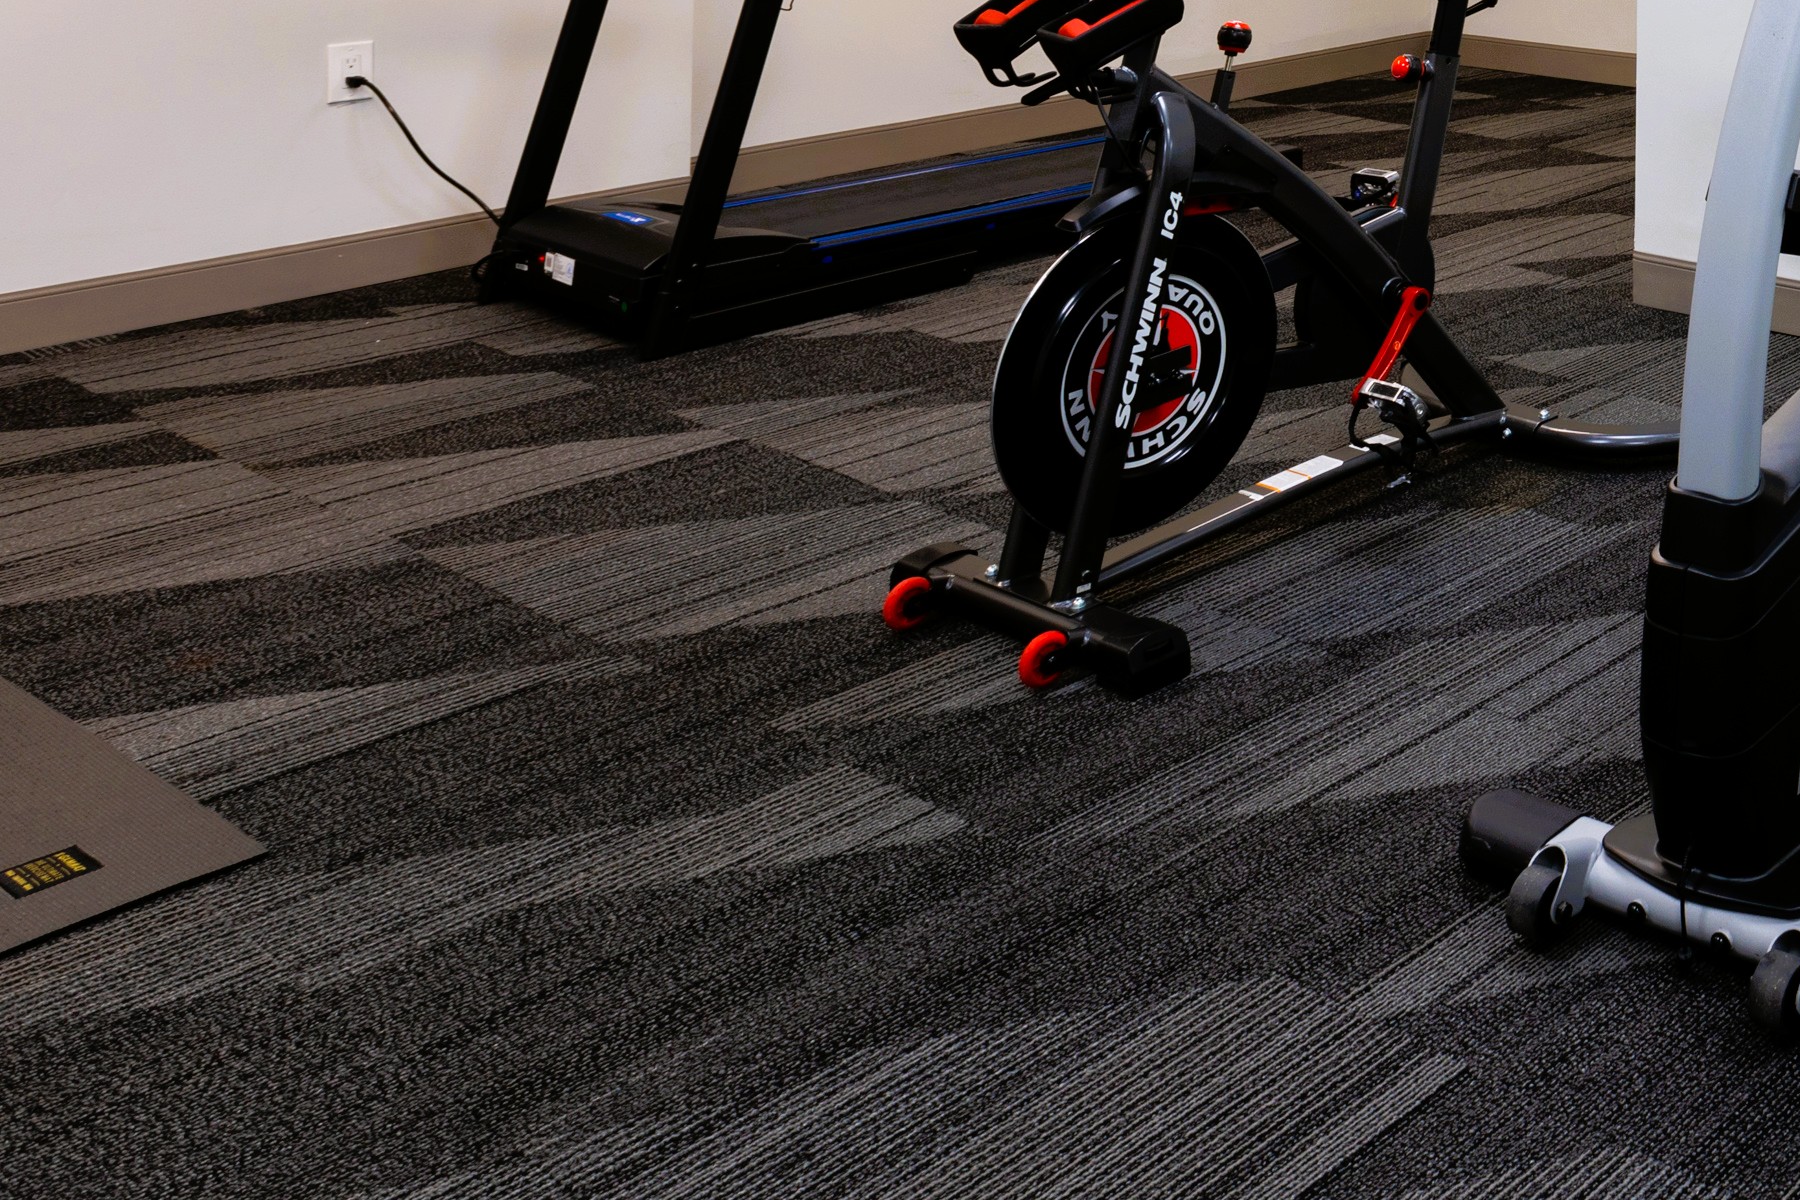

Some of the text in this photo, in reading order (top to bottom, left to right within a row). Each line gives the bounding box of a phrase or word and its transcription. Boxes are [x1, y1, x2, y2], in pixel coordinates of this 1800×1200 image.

[1101, 283, 1215, 336] QUAY
[1115, 191, 1184, 429] SCHWINN IC4
[1068, 388, 1206, 458] SCHNN
